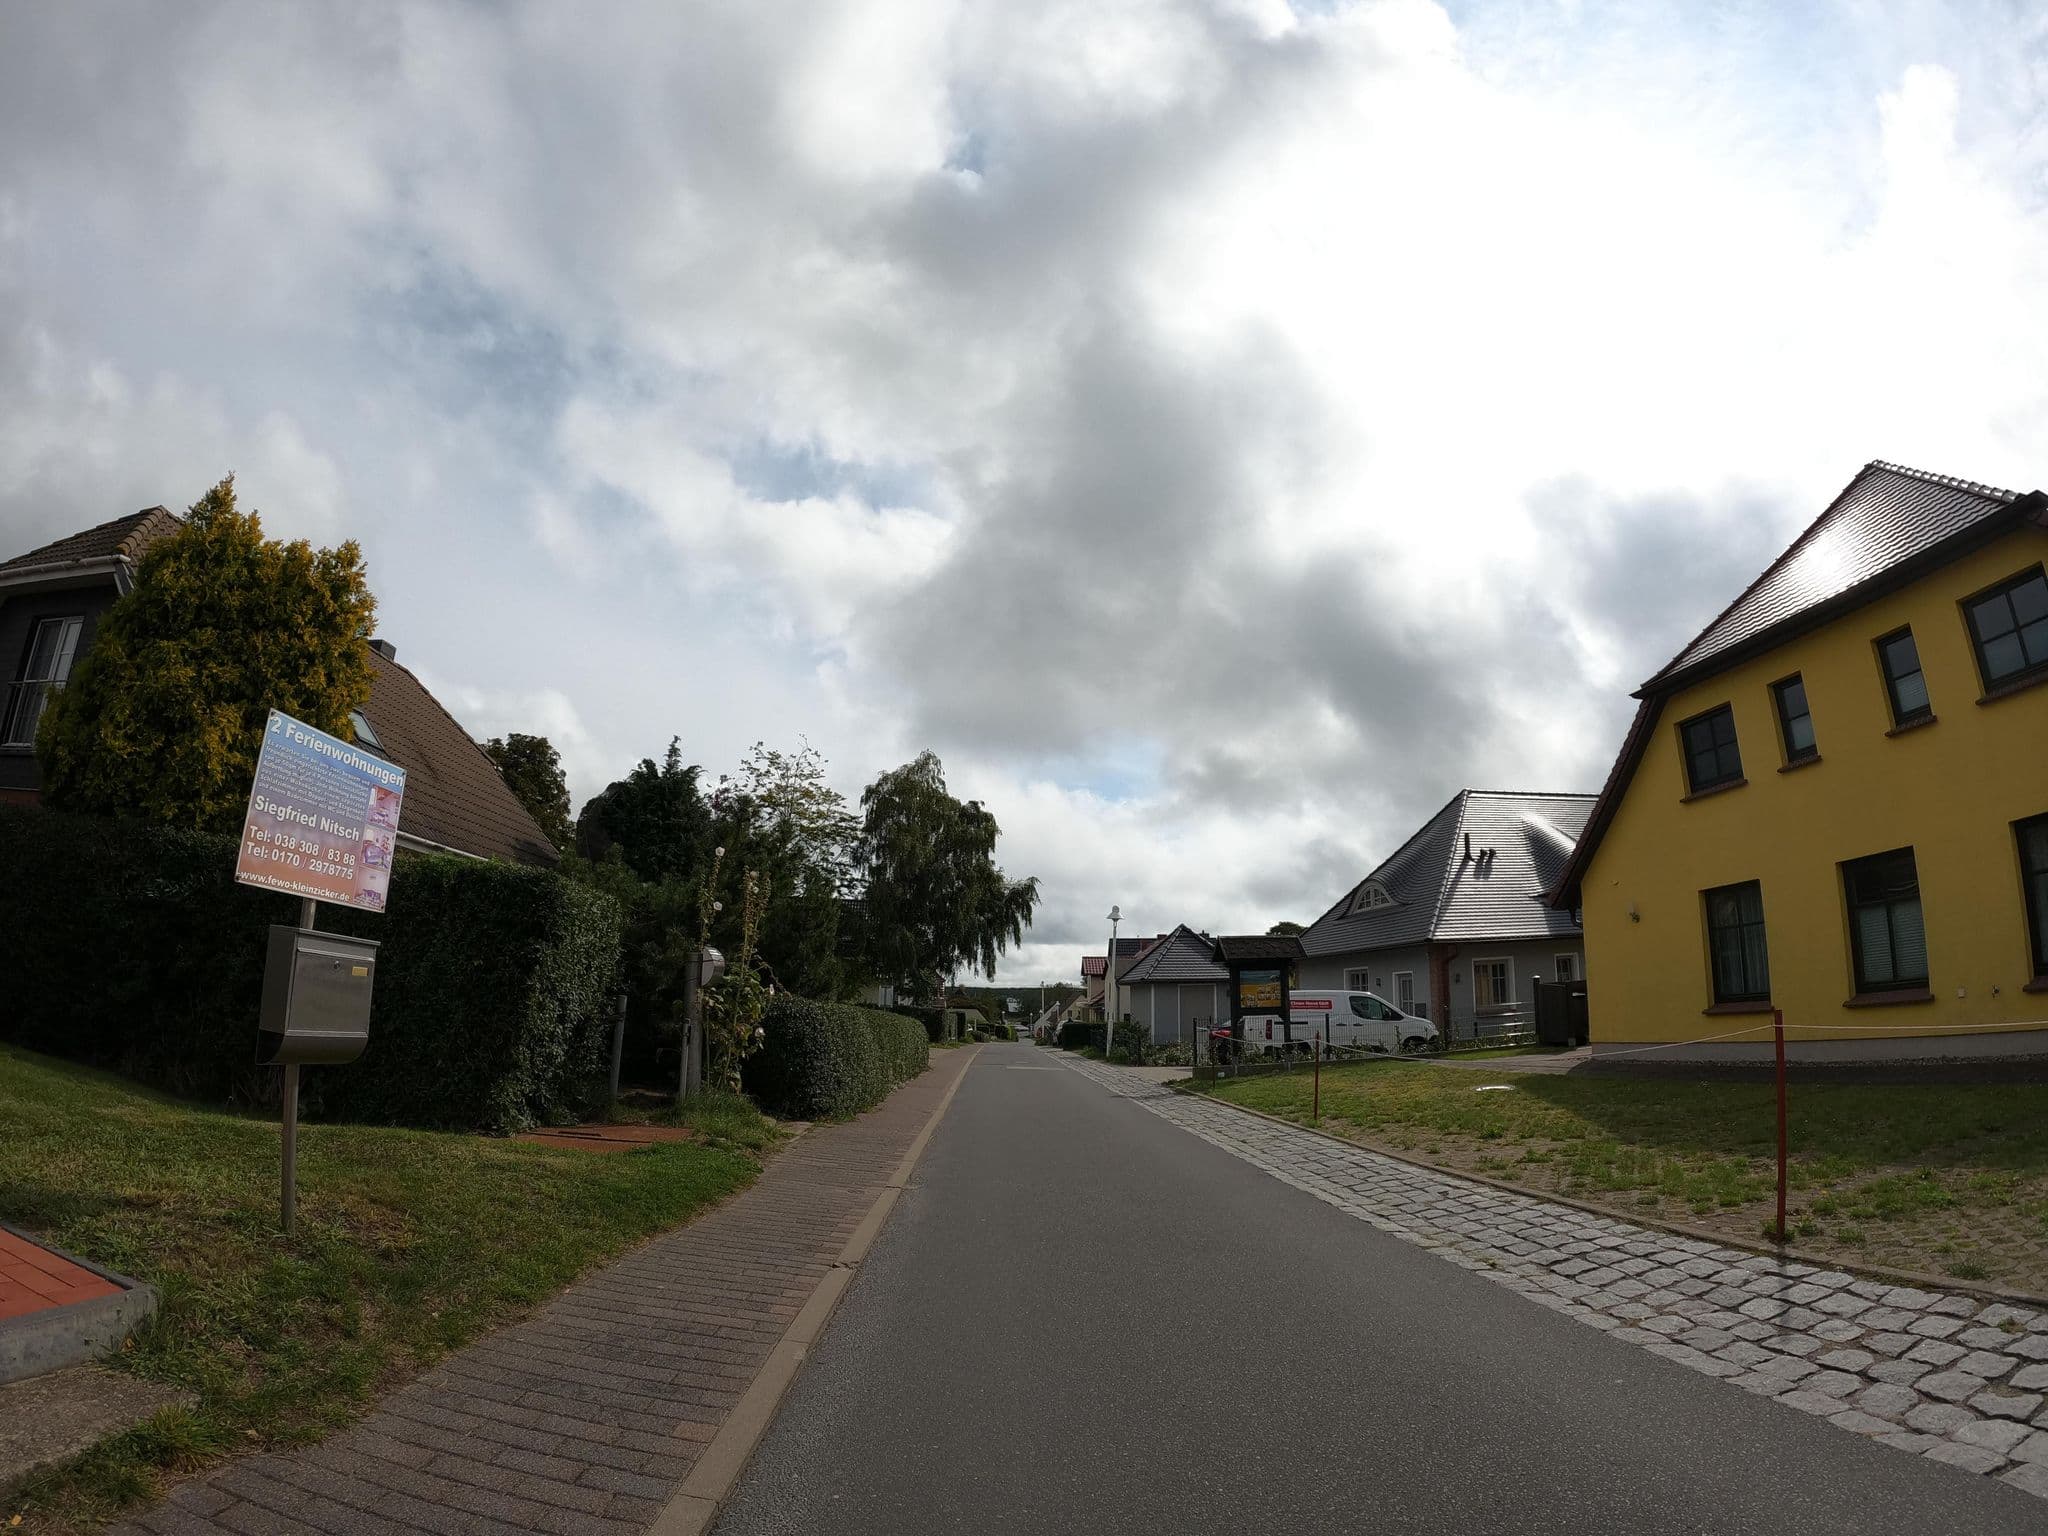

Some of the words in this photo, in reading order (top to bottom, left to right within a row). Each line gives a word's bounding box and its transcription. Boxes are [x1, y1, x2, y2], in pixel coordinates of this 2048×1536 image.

[270, 717, 281, 735] 2
[285, 724, 404, 787] Ferienwohnungen
[254, 795, 316, 828] Siegfried
[319, 816, 360, 841] Nitsch
[247, 841, 268, 859] Tel:
[271, 849, 300, 867] 0170
[309, 859, 353, 881] 2978775
[250, 826, 270, 843] Tel:
[274, 833, 296, 850] 038
[299, 840, 320, 857] 308
[328, 849, 340, 863] 83
[343, 853, 356, 867] 88
[240, 871, 350, 902] www.fewo-kleinzicker.de
